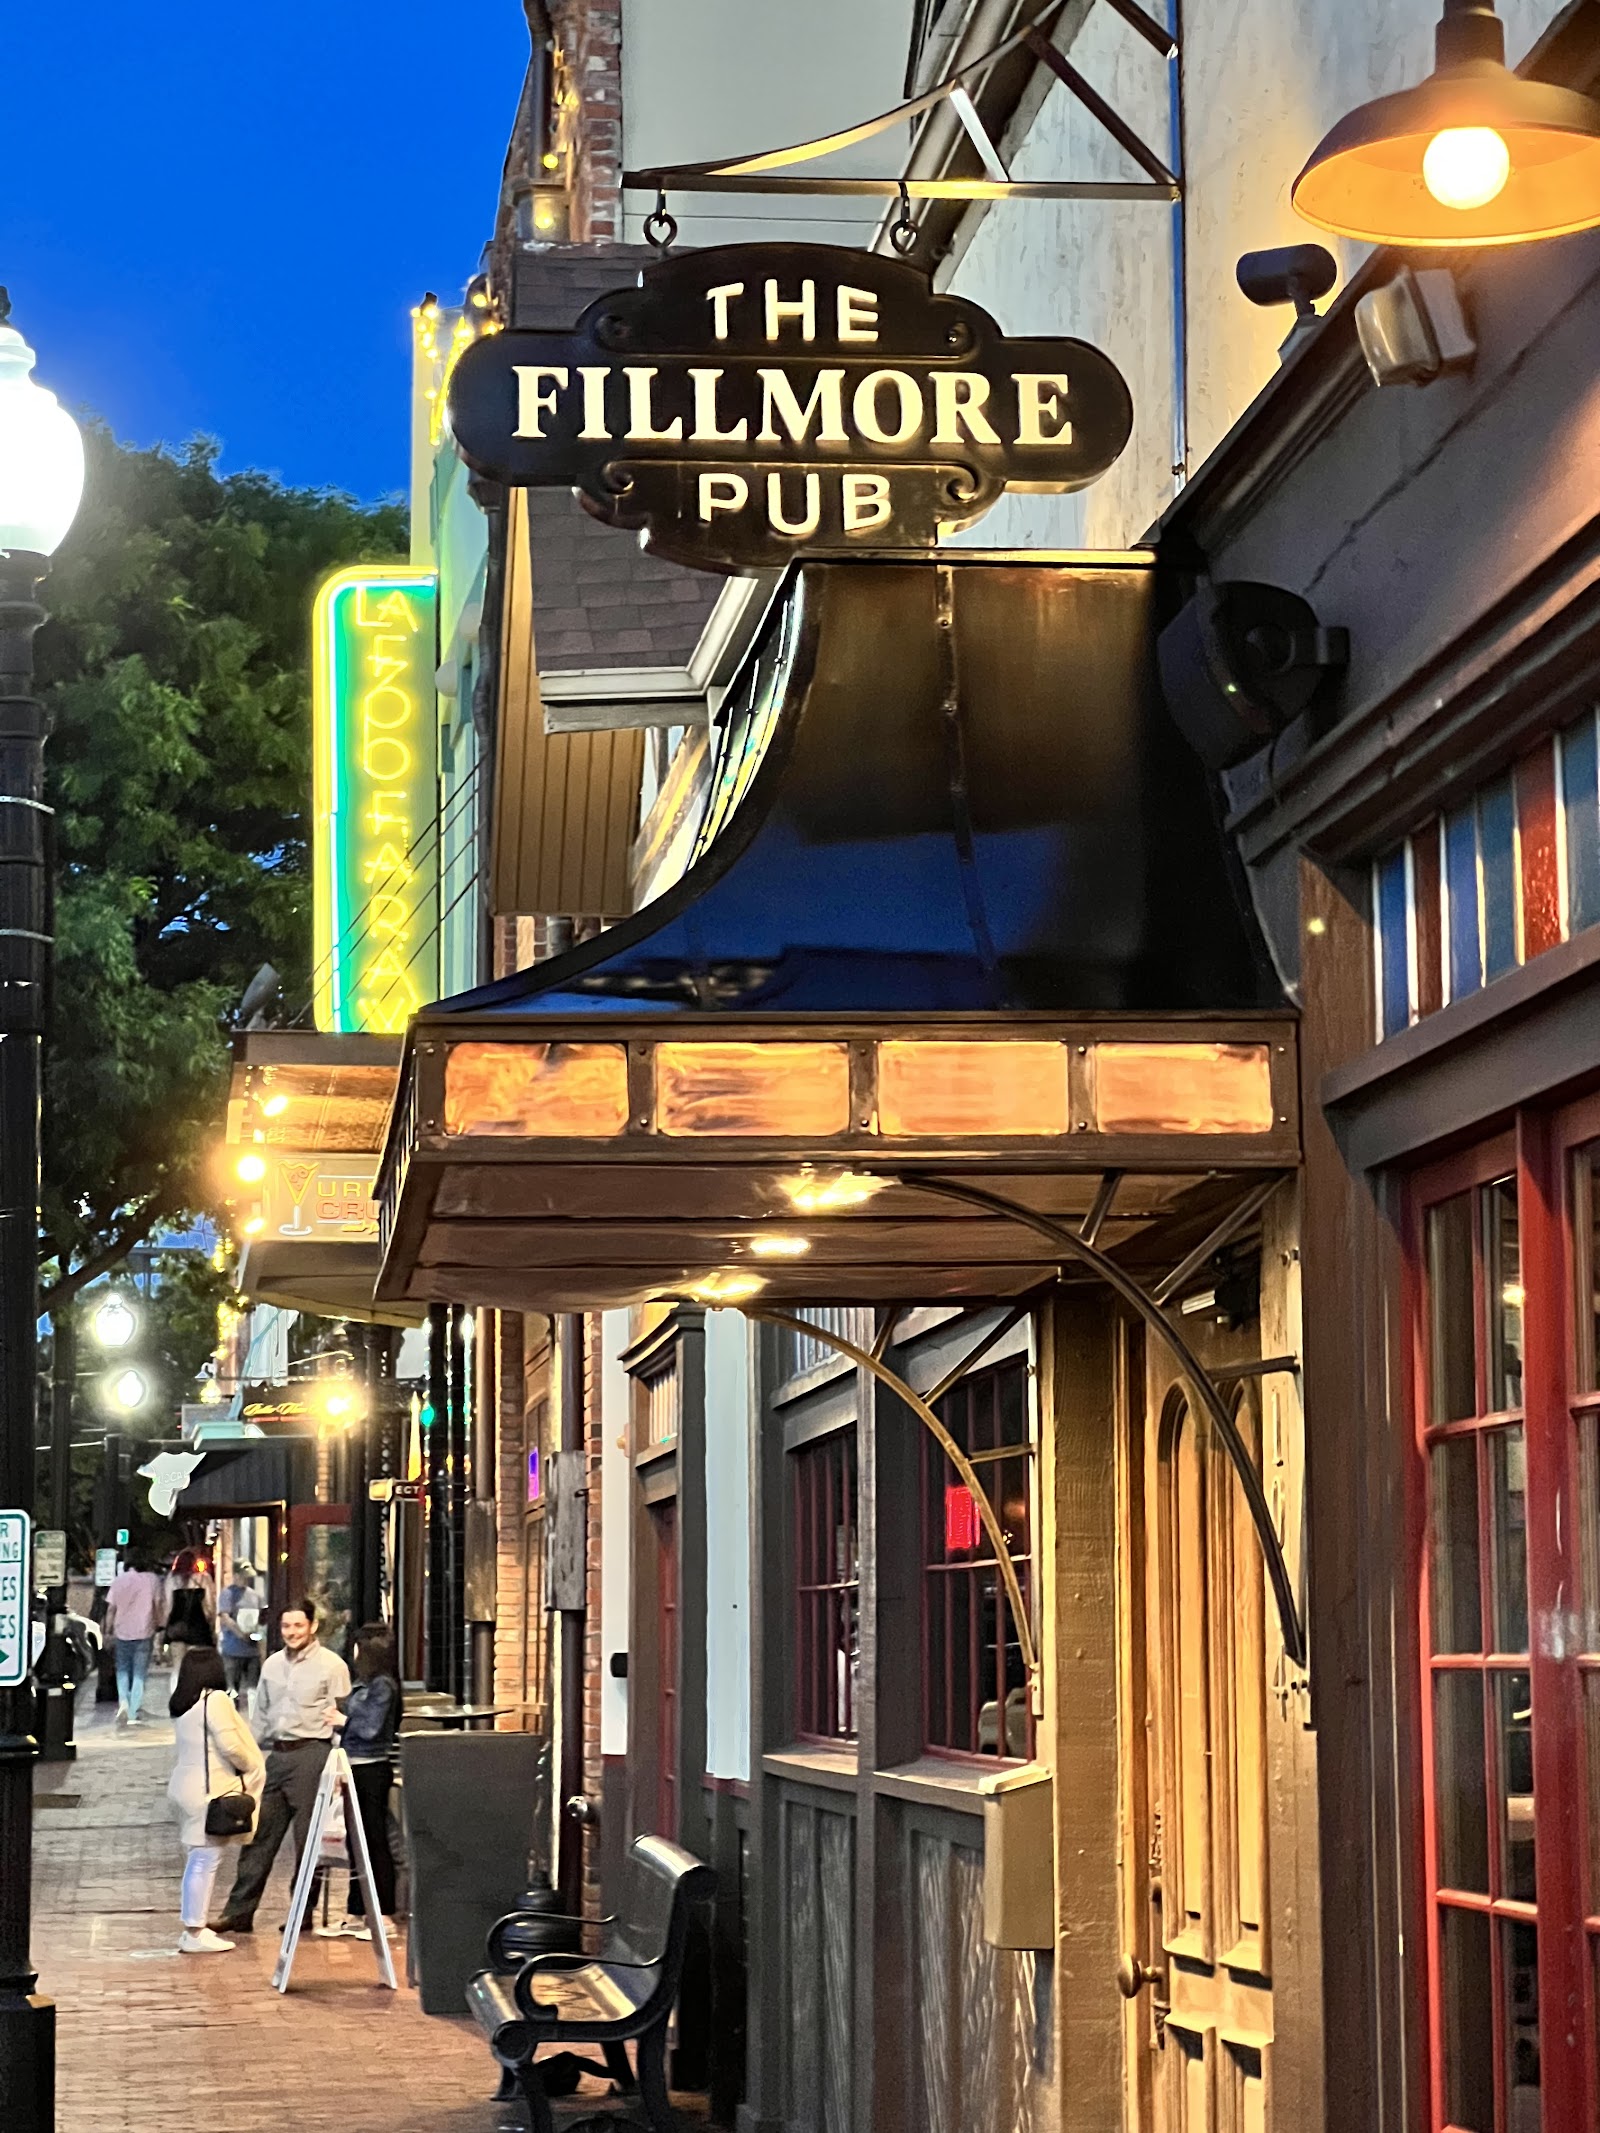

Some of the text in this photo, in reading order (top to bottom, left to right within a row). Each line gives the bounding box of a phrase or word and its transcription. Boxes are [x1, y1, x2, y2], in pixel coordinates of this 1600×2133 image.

[706, 278, 879, 342] THE
[511, 365, 1074, 446] FILLMORE
[698, 472, 892, 539] PUB
